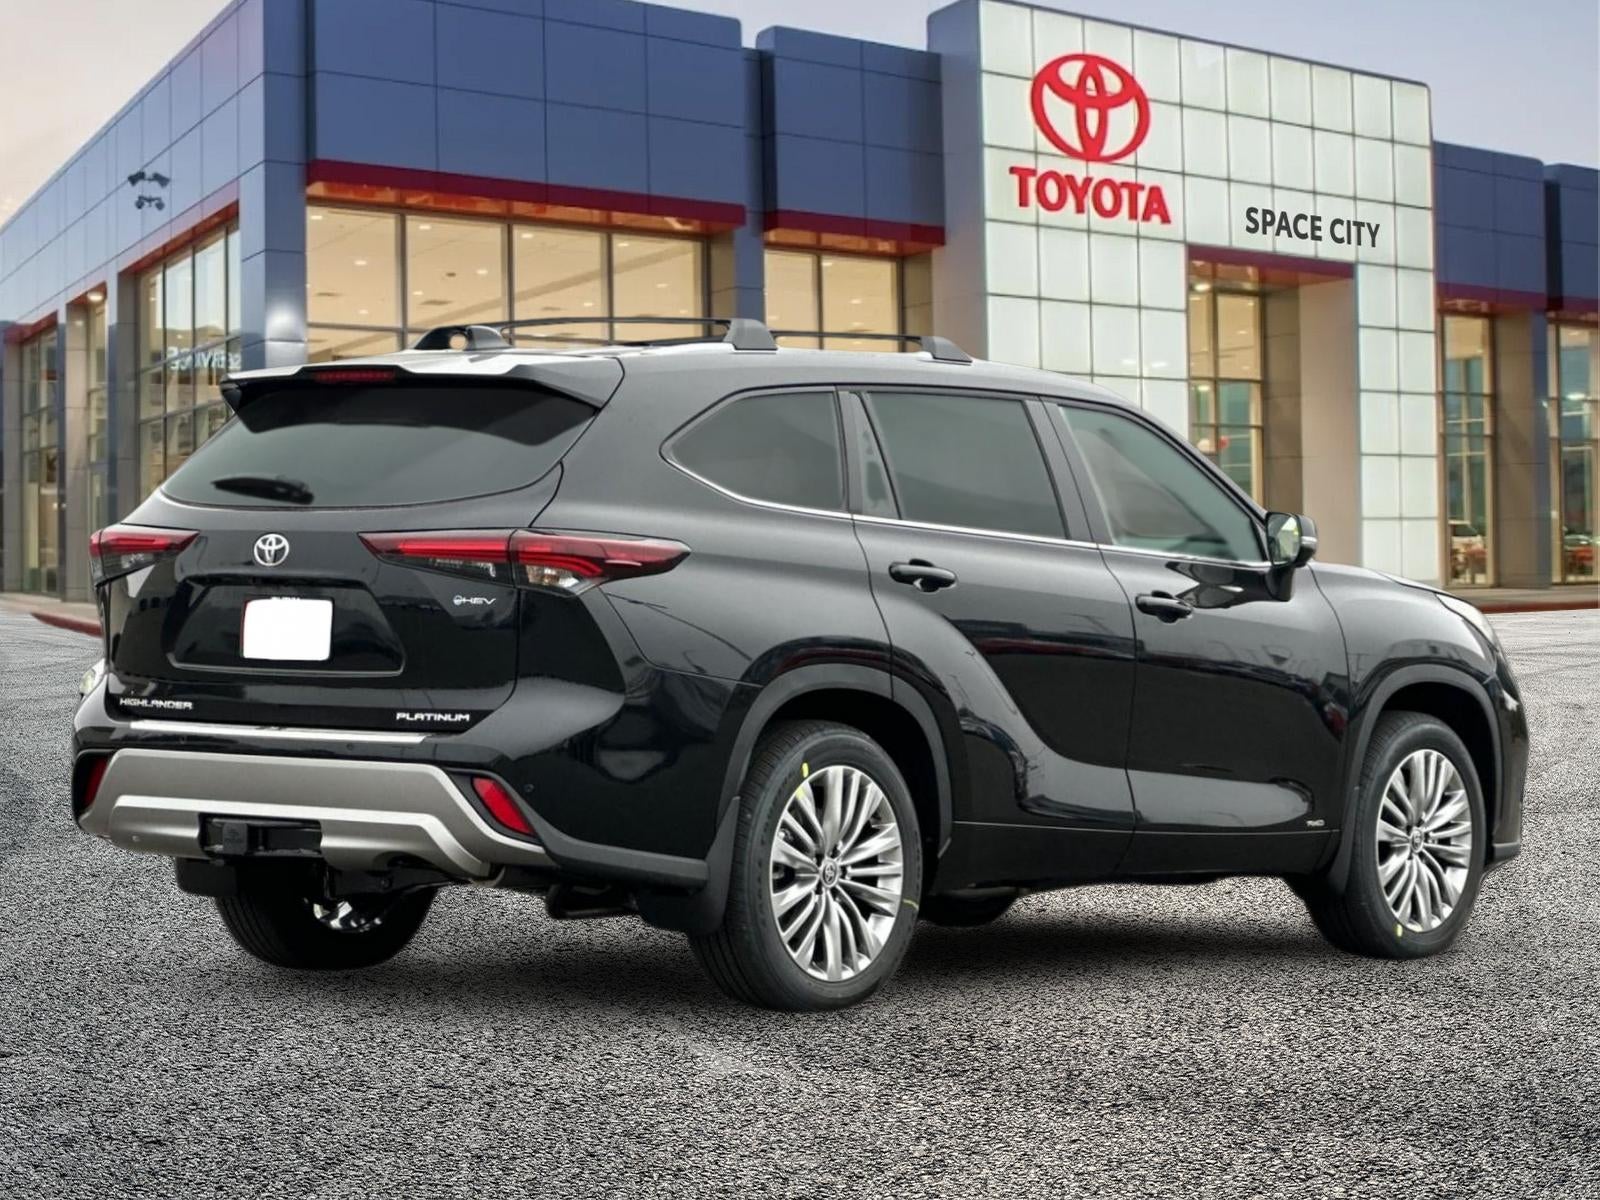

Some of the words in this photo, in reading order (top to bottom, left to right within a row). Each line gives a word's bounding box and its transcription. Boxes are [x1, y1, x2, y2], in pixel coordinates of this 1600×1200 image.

[1009, 166, 1171, 224] TOYOTA
[1245, 206, 1323, 242] SPACE
[1329, 217, 1381, 248] CITY
[119, 698, 193, 710] HIGHLANDER
[396, 712, 470, 722] PLATINUM
